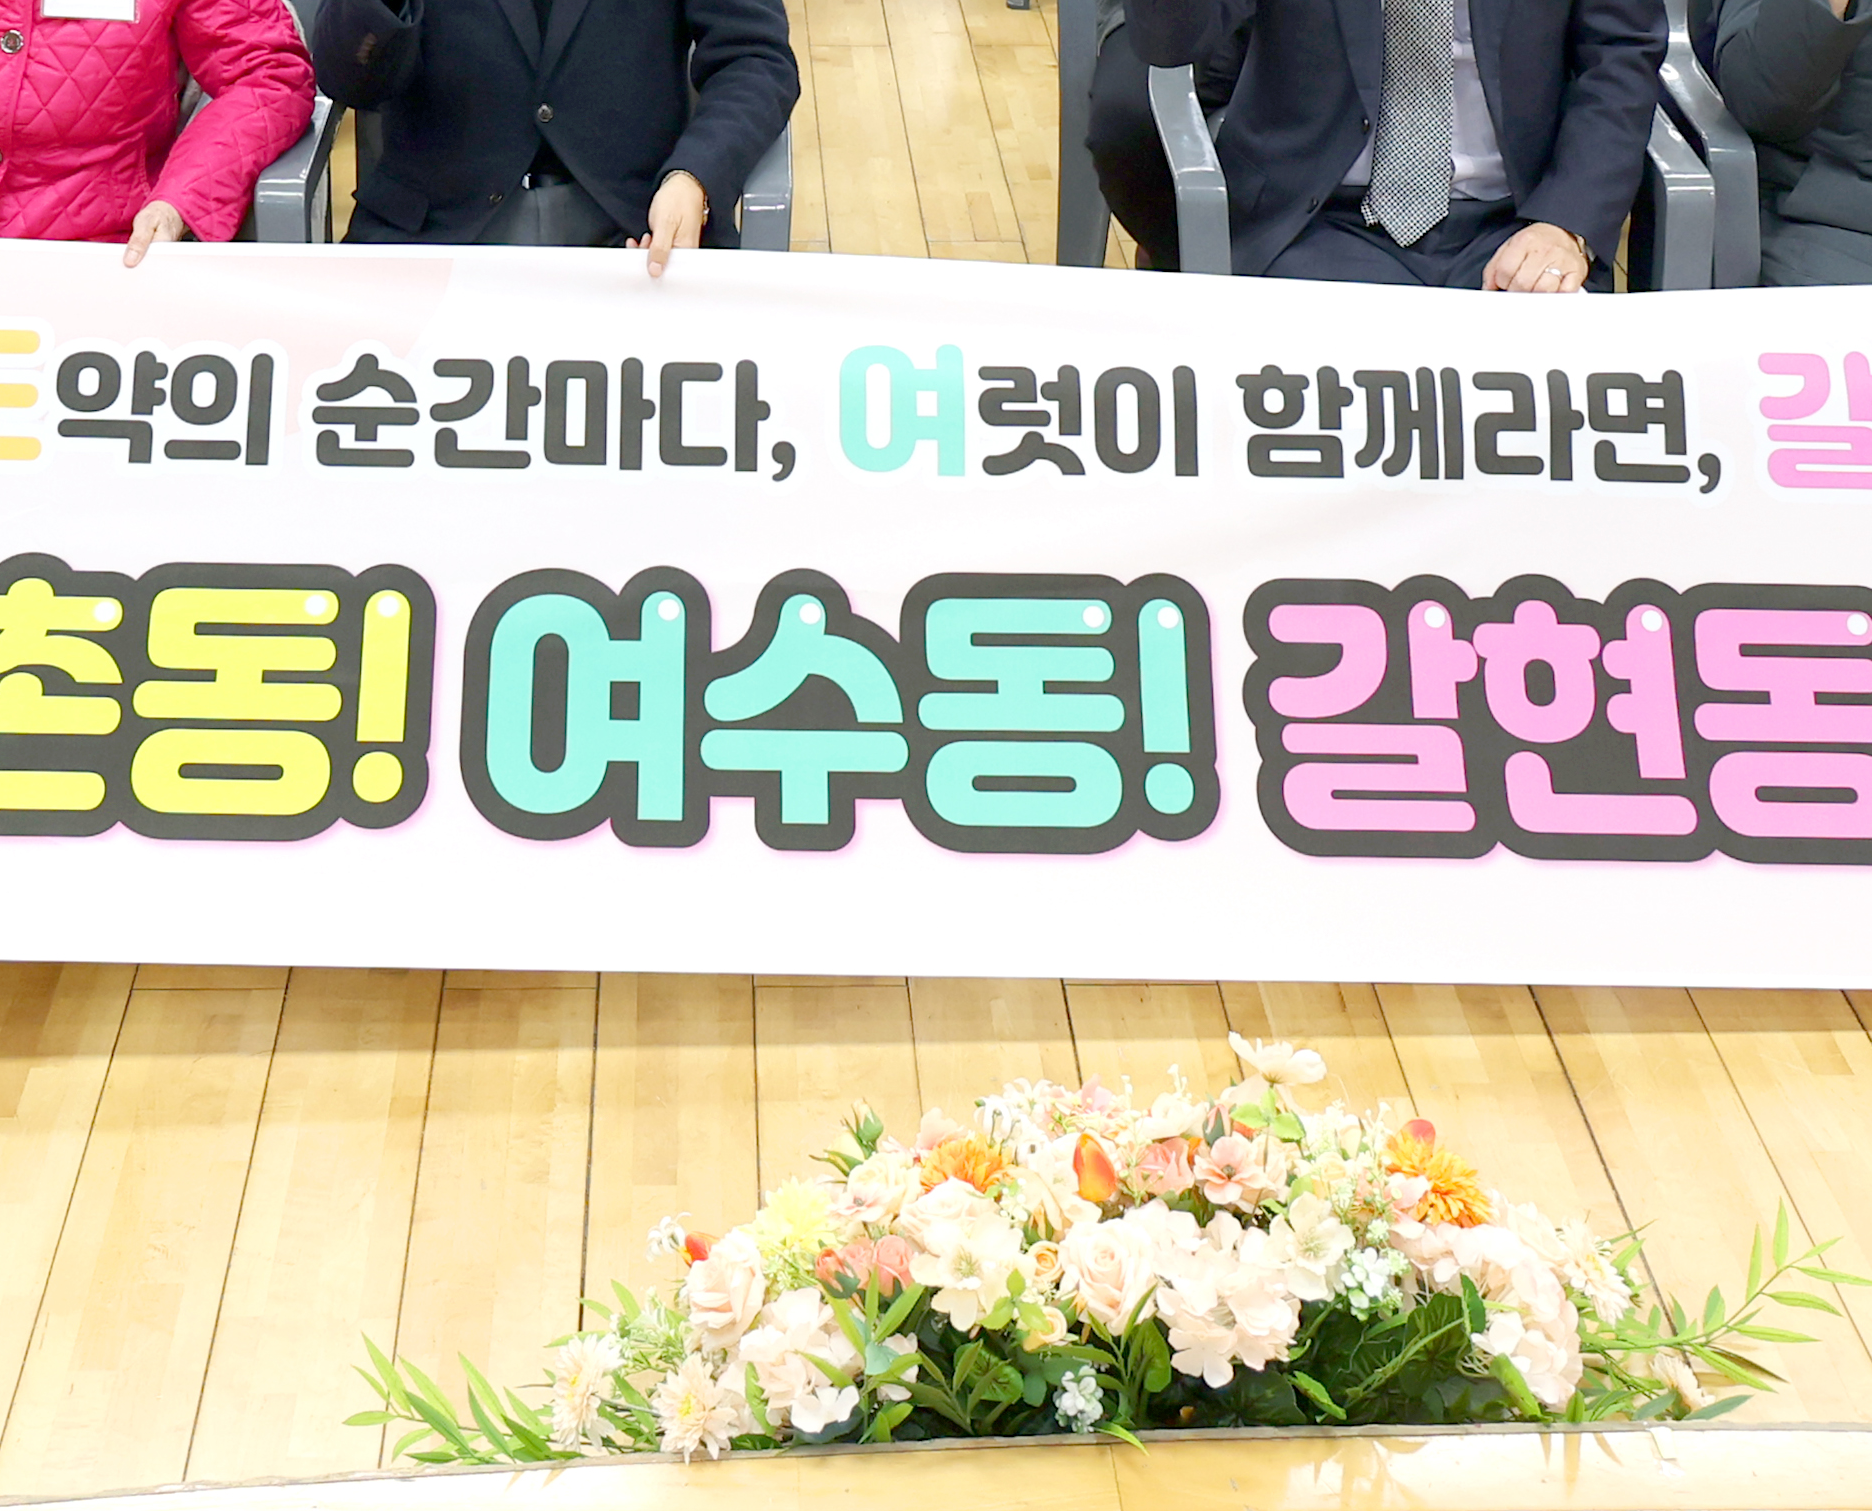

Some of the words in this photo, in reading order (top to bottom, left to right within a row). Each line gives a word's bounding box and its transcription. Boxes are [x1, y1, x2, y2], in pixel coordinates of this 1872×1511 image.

[313, 353, 796, 484] 순간마다,
[837, 347, 1200, 479] 여럿이
[1236, 366, 1722, 497] 함께라면,
[479, 586, 1202, 830] 여수동!
